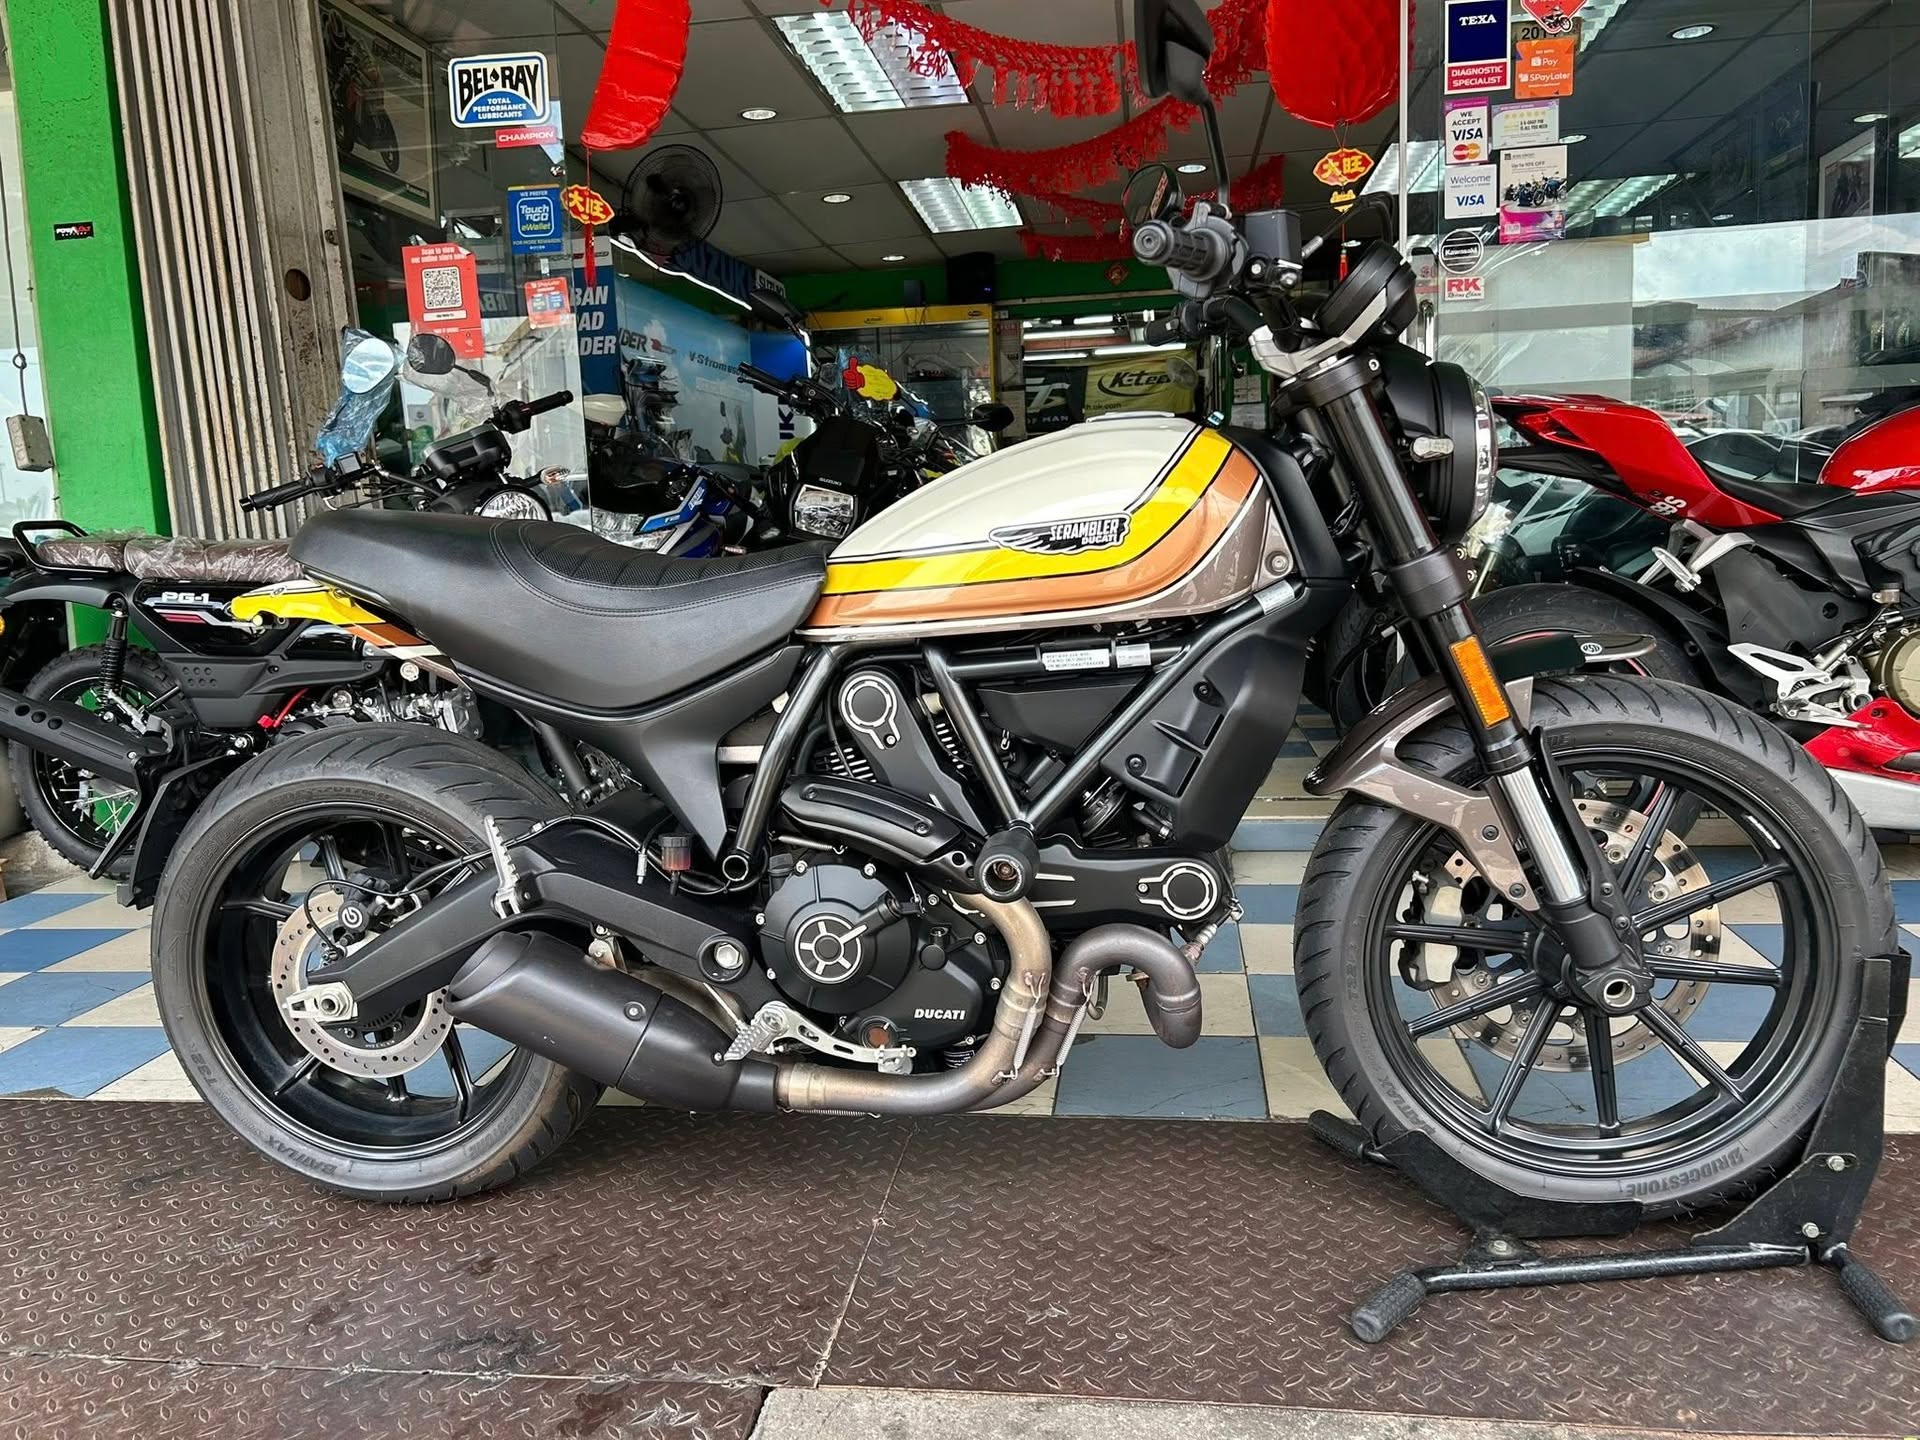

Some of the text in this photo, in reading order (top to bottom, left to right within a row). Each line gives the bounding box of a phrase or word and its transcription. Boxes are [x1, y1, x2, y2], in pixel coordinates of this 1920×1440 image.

[1459, 14, 1497, 26] TEXA
[1451, 66, 1503, 77] DIAGNOSTIC
[1529, 72, 1571, 82] SPayLater
[1452, 76, 1502, 87] SPECIALIST
[487, 97, 511, 105] TOTAL
[472, 103, 527, 113] PERFORMANCE
[478, 111, 523, 119] LUBRICANTS
[1452, 118, 1481, 126] ACCEPT
[498, 131, 554, 142] CHAMPION
[1451, 128, 1483, 141] VISA
[1450, 175, 1491, 185] Welcome
[1456, 194, 1485, 207] VISA
[520, 204, 550, 214] Touch
[521, 223, 551, 231] eWallet
[1445, 247, 1478, 256] Kawasaki
[1447, 278, 1481, 292] RK
[1050, 519, 1119, 541] SCRAMBLER
[1081, 533, 1118, 545] DUCATI
[162, 591, 209, 604] PG-1
[914, 1008, 966, 1020] DUCATI
[1626, 1146, 1745, 1197] BRIDGESTONE
